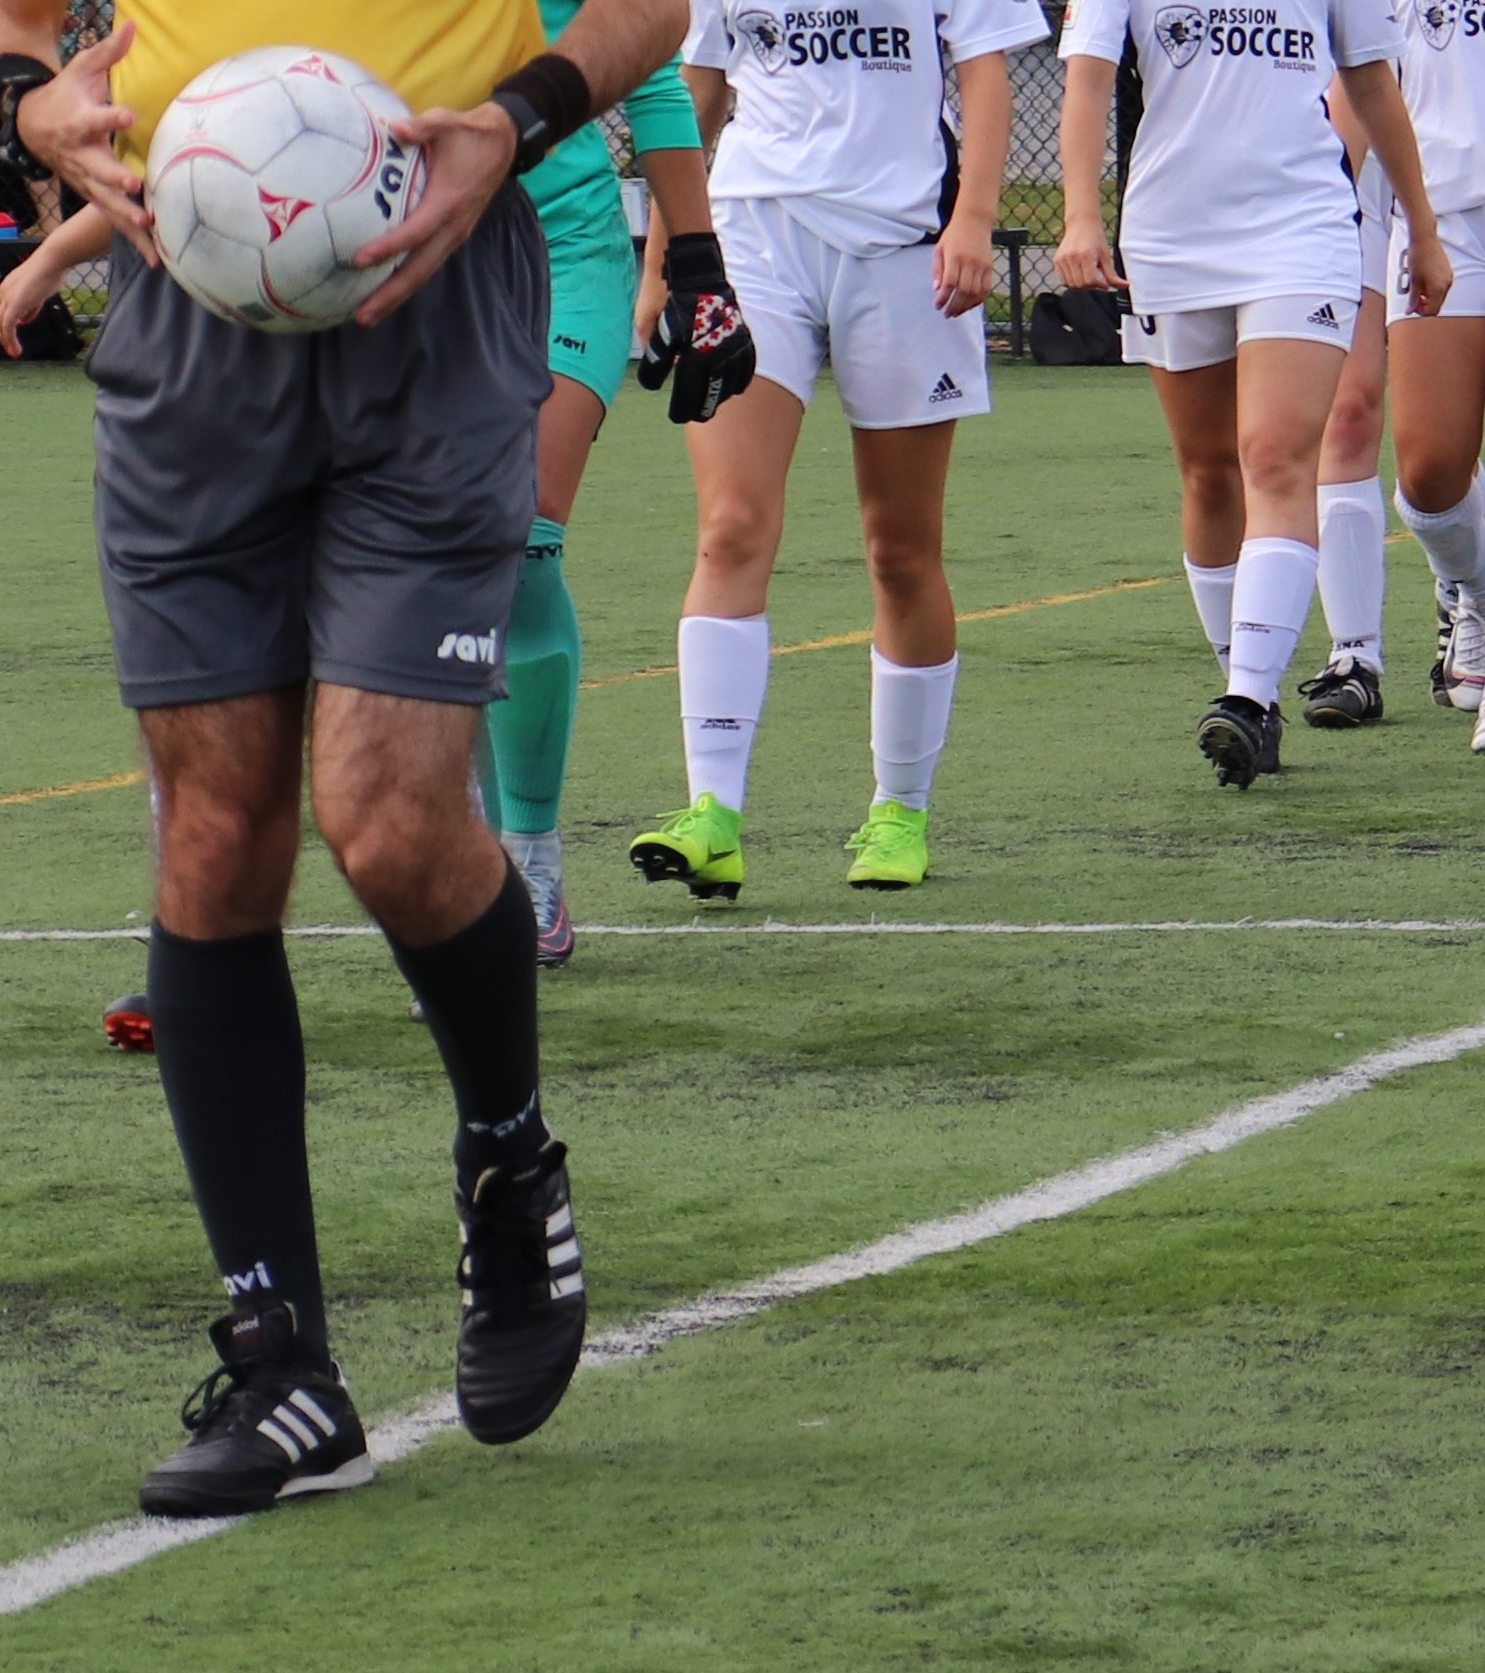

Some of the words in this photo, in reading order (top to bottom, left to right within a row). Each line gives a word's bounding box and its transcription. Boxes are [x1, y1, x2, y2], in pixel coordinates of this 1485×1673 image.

[785, 9, 859, 30] PASSION
[1209, 8, 1277, 25] PASSION
[788, 27, 911, 66] SOCCER
[1210, 27, 1315, 60] SOCCER
[861, 60, 912, 74] Boutique
[1273, 60, 1316, 74] Boutique
[373, 134, 408, 221] sav
[1307, 315, 1340, 330] adidas
[553, 334, 586, 355] savi
[928, 389, 963, 404] adidas
[437, 627, 496, 666] savi
[223, 1261, 272, 1296] avi
